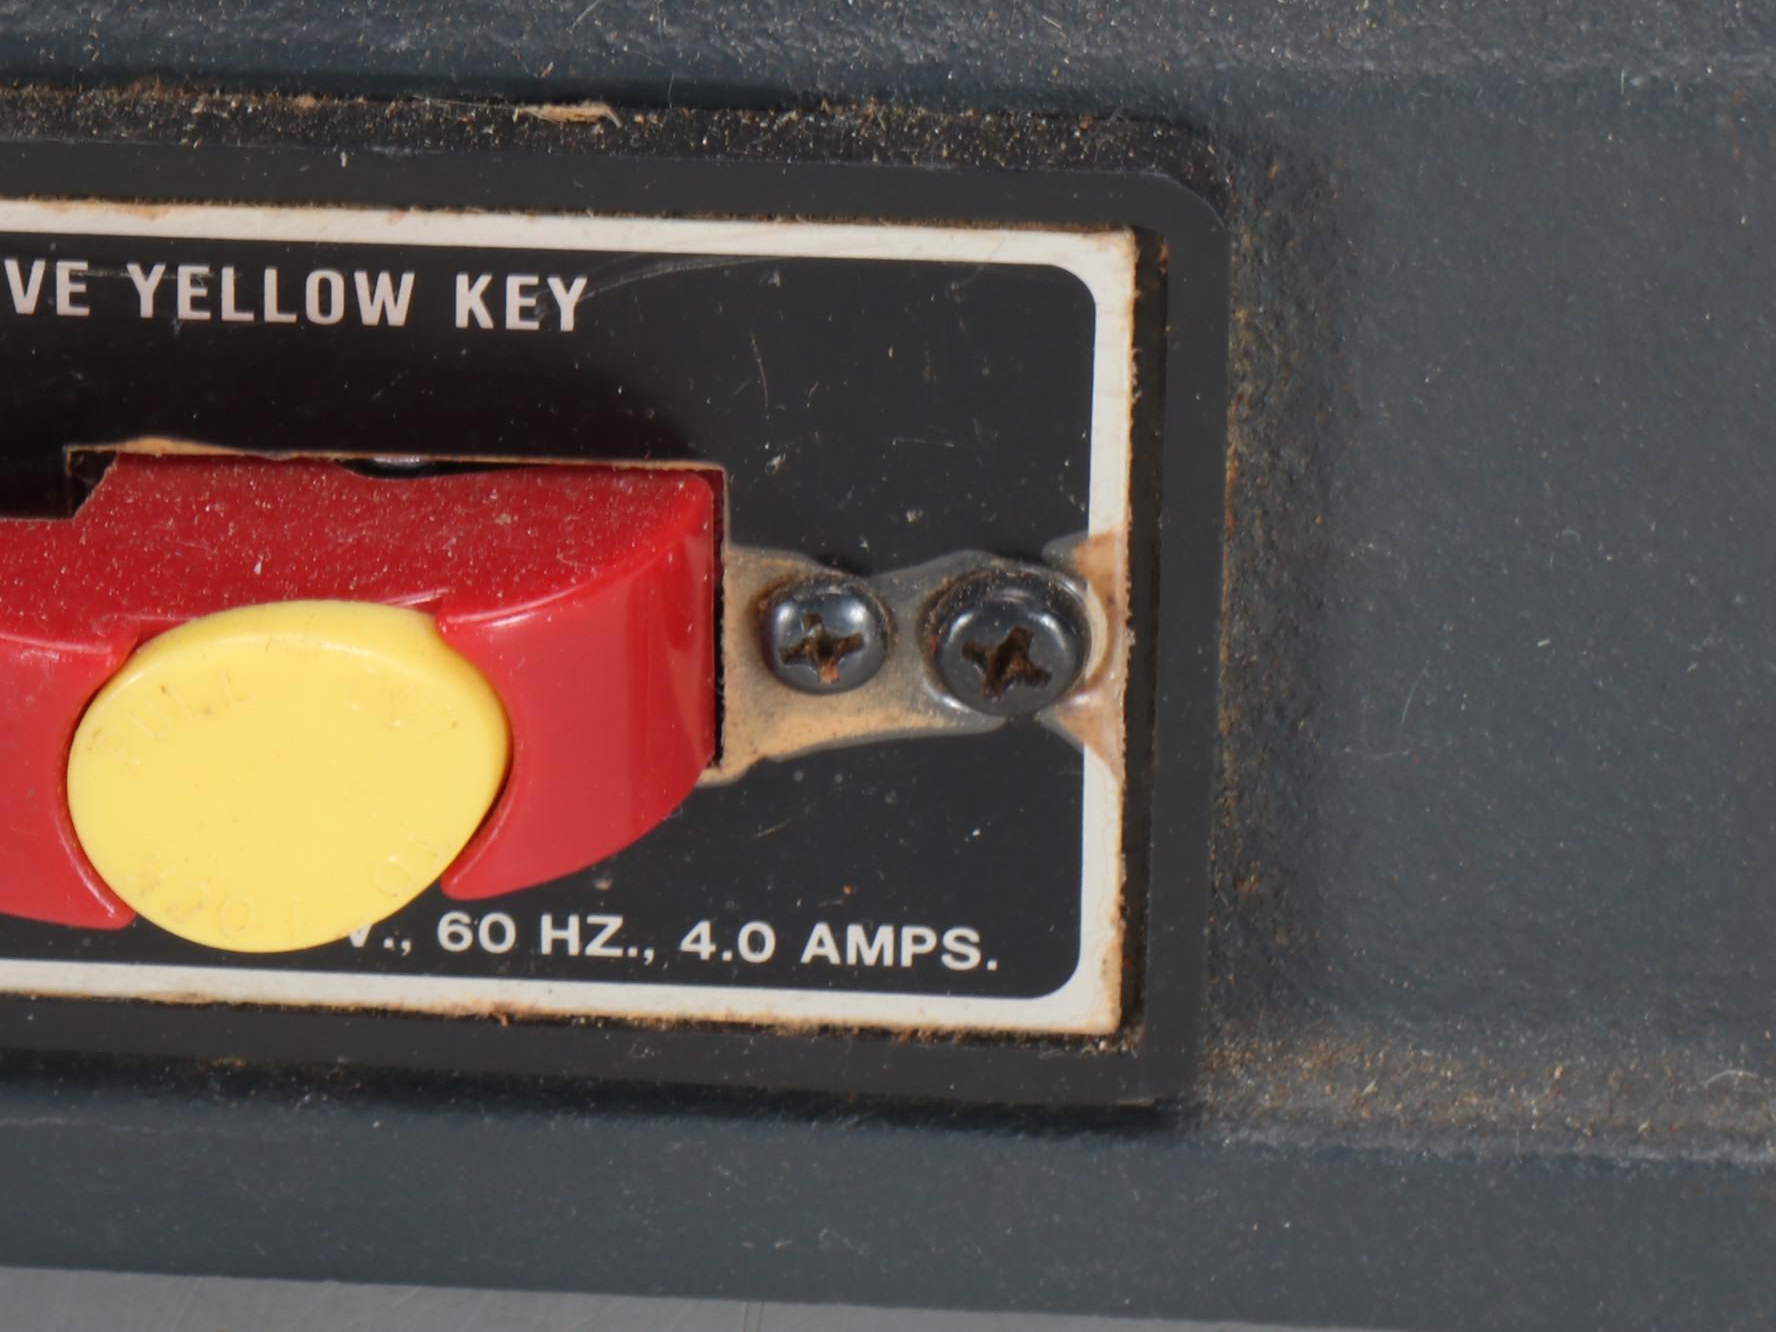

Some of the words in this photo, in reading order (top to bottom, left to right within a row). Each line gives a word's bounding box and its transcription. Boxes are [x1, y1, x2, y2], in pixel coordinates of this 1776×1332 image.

[127, 264, 415, 326] YELLOW
[455, 274, 588, 332] KEY
[437, 911, 517, 954] 60
[540, 914, 654, 965] HZ.,
[680, 921, 776, 964] 4.0
[800, 922, 998, 971] AMPS.
